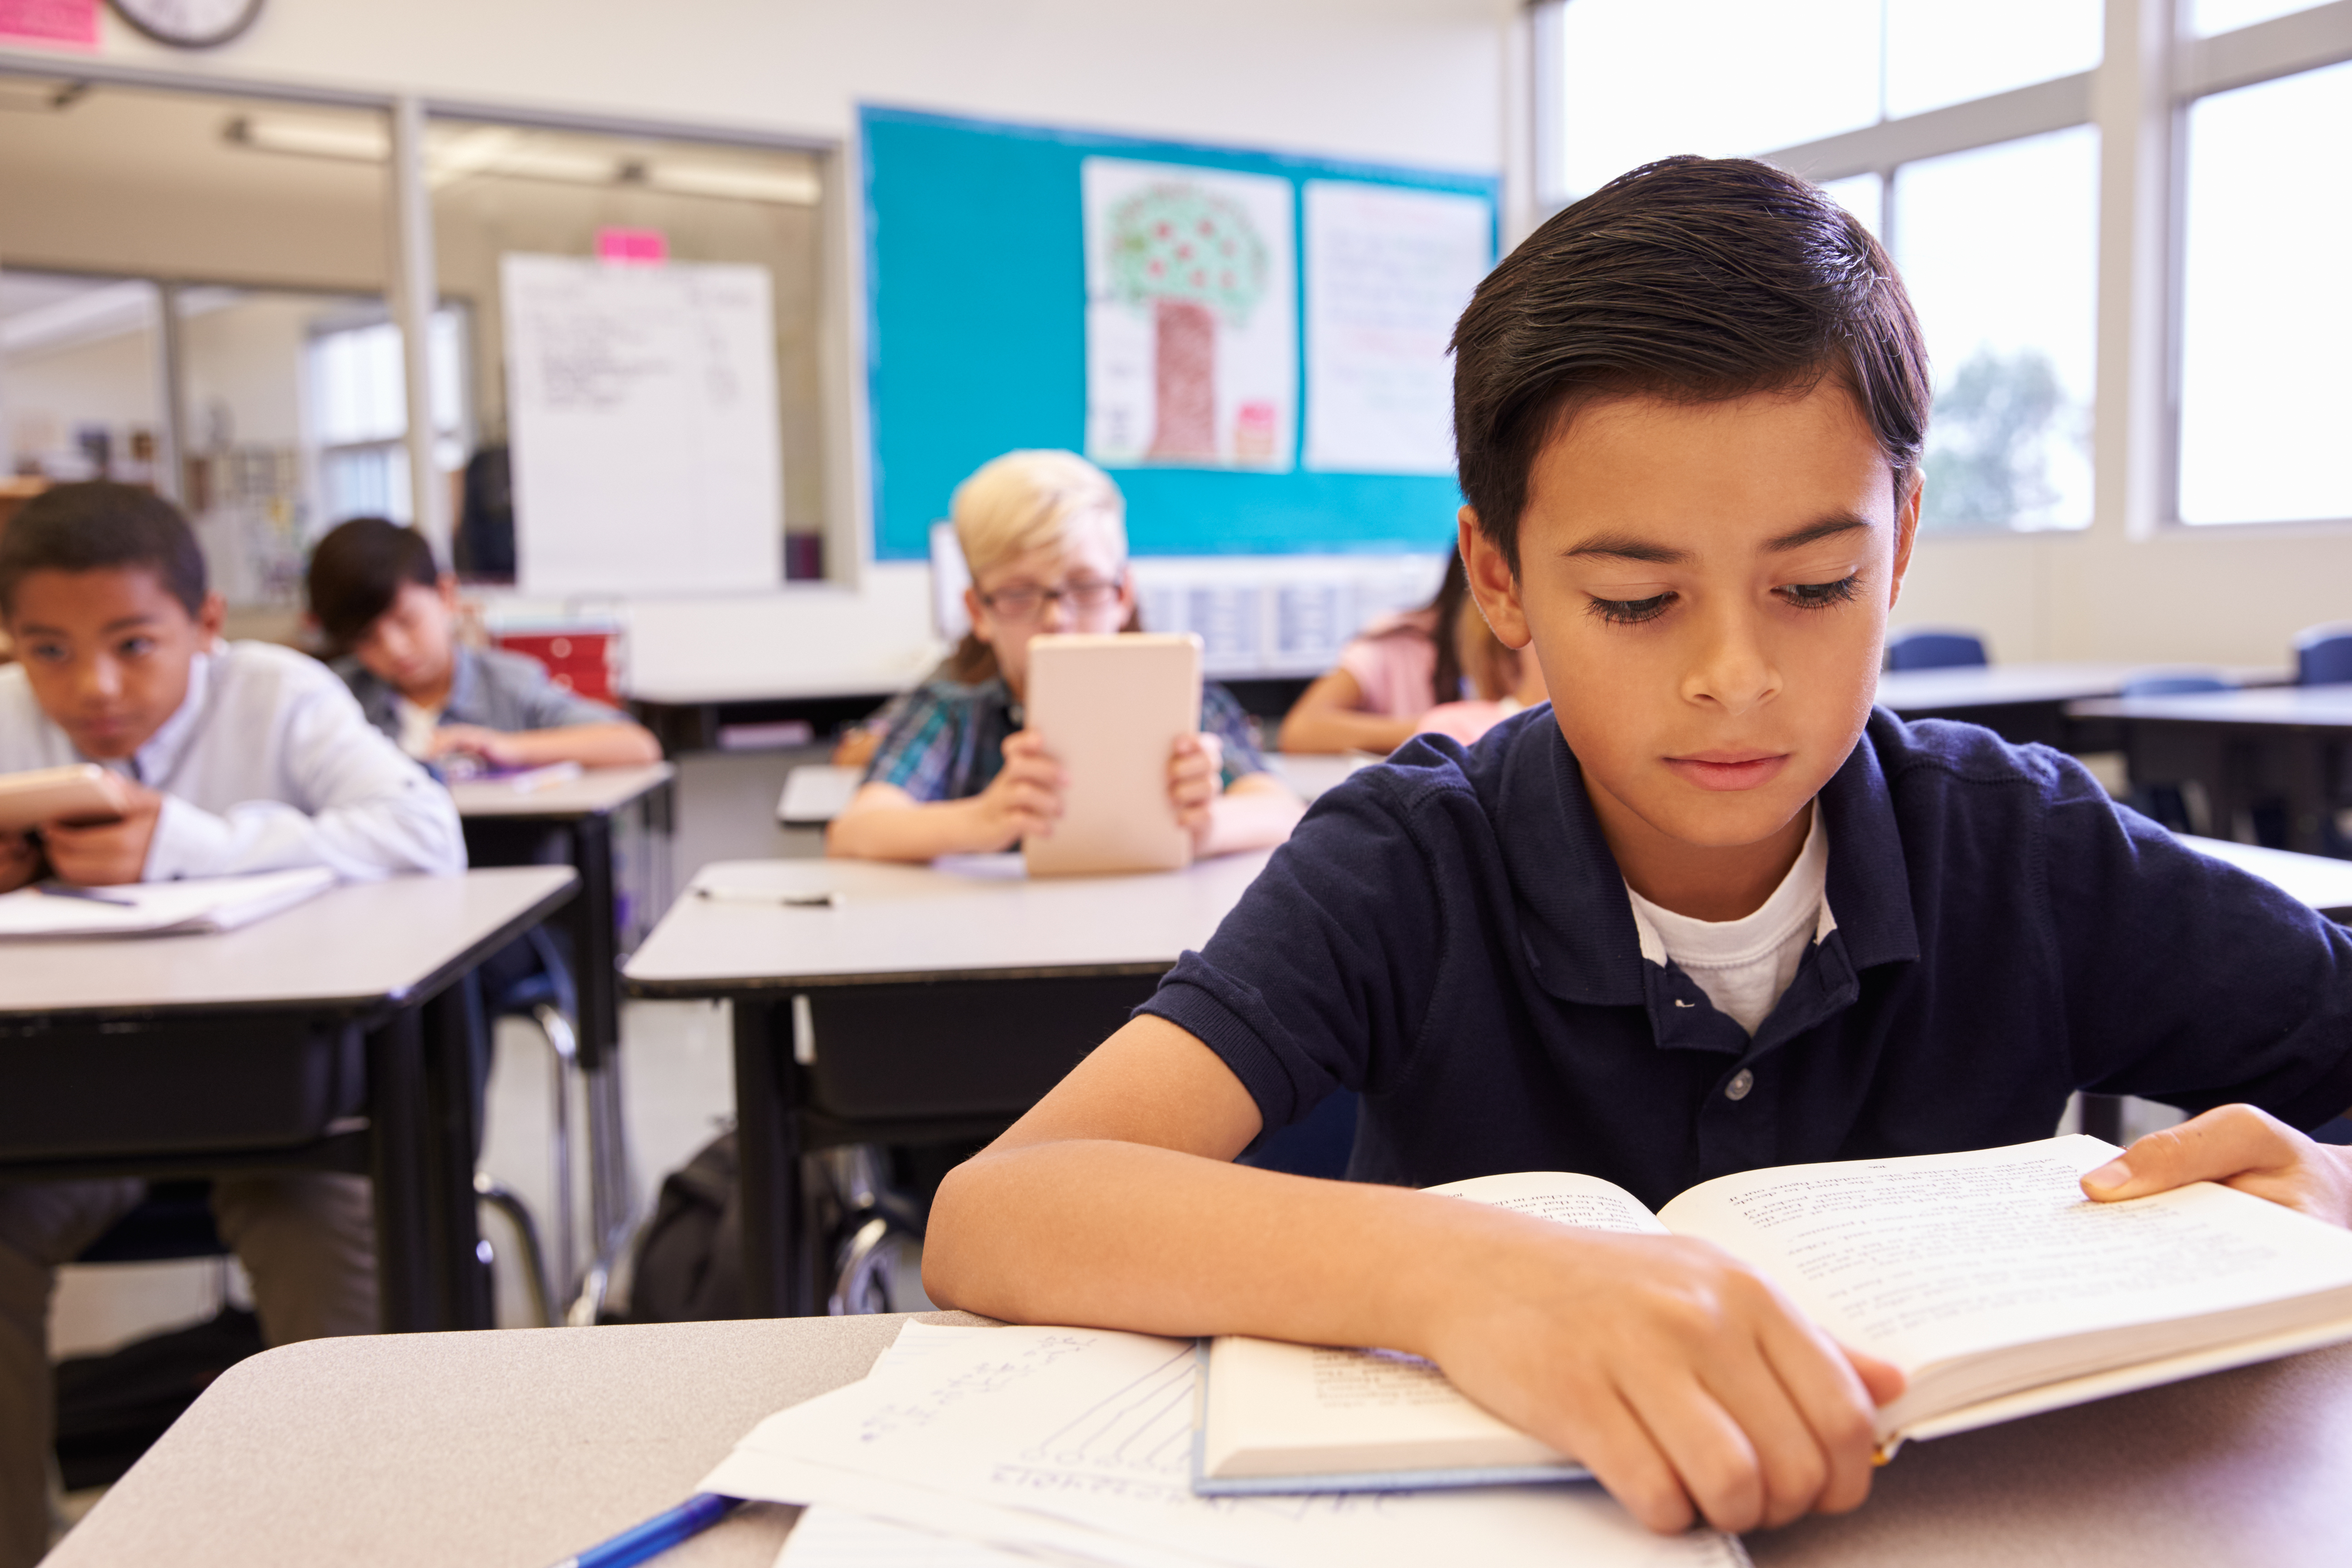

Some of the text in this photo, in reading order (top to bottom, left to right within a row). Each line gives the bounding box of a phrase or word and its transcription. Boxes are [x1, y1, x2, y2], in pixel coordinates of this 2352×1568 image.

[2029, 1169, 2078, 1178] Agency
[2025, 1174, 2078, 1183] nvelope
[1770, 1182, 1809, 1190] figure
[1816, 1190, 1866, 1198] outside
[1596, 1196, 1622, 1204] ting
[1733, 1192, 1777, 1206] decide
[1763, 1196, 1808, 1209] pocket
[1815, 1195, 1865, 1203] Clutch
[1596, 1202, 1627, 1210] back
[1812, 1201, 1851, 1210] could
[1743, 1209, 1756, 1217] of
[1749, 1203, 1802, 1220] Literary
[1753, 1216, 1775, 1225] the
[1758, 1215, 1803, 1230] seven-
[1785, 1221, 1856, 1243] promise."
[1838, 1231, 1872, 1241] said,
